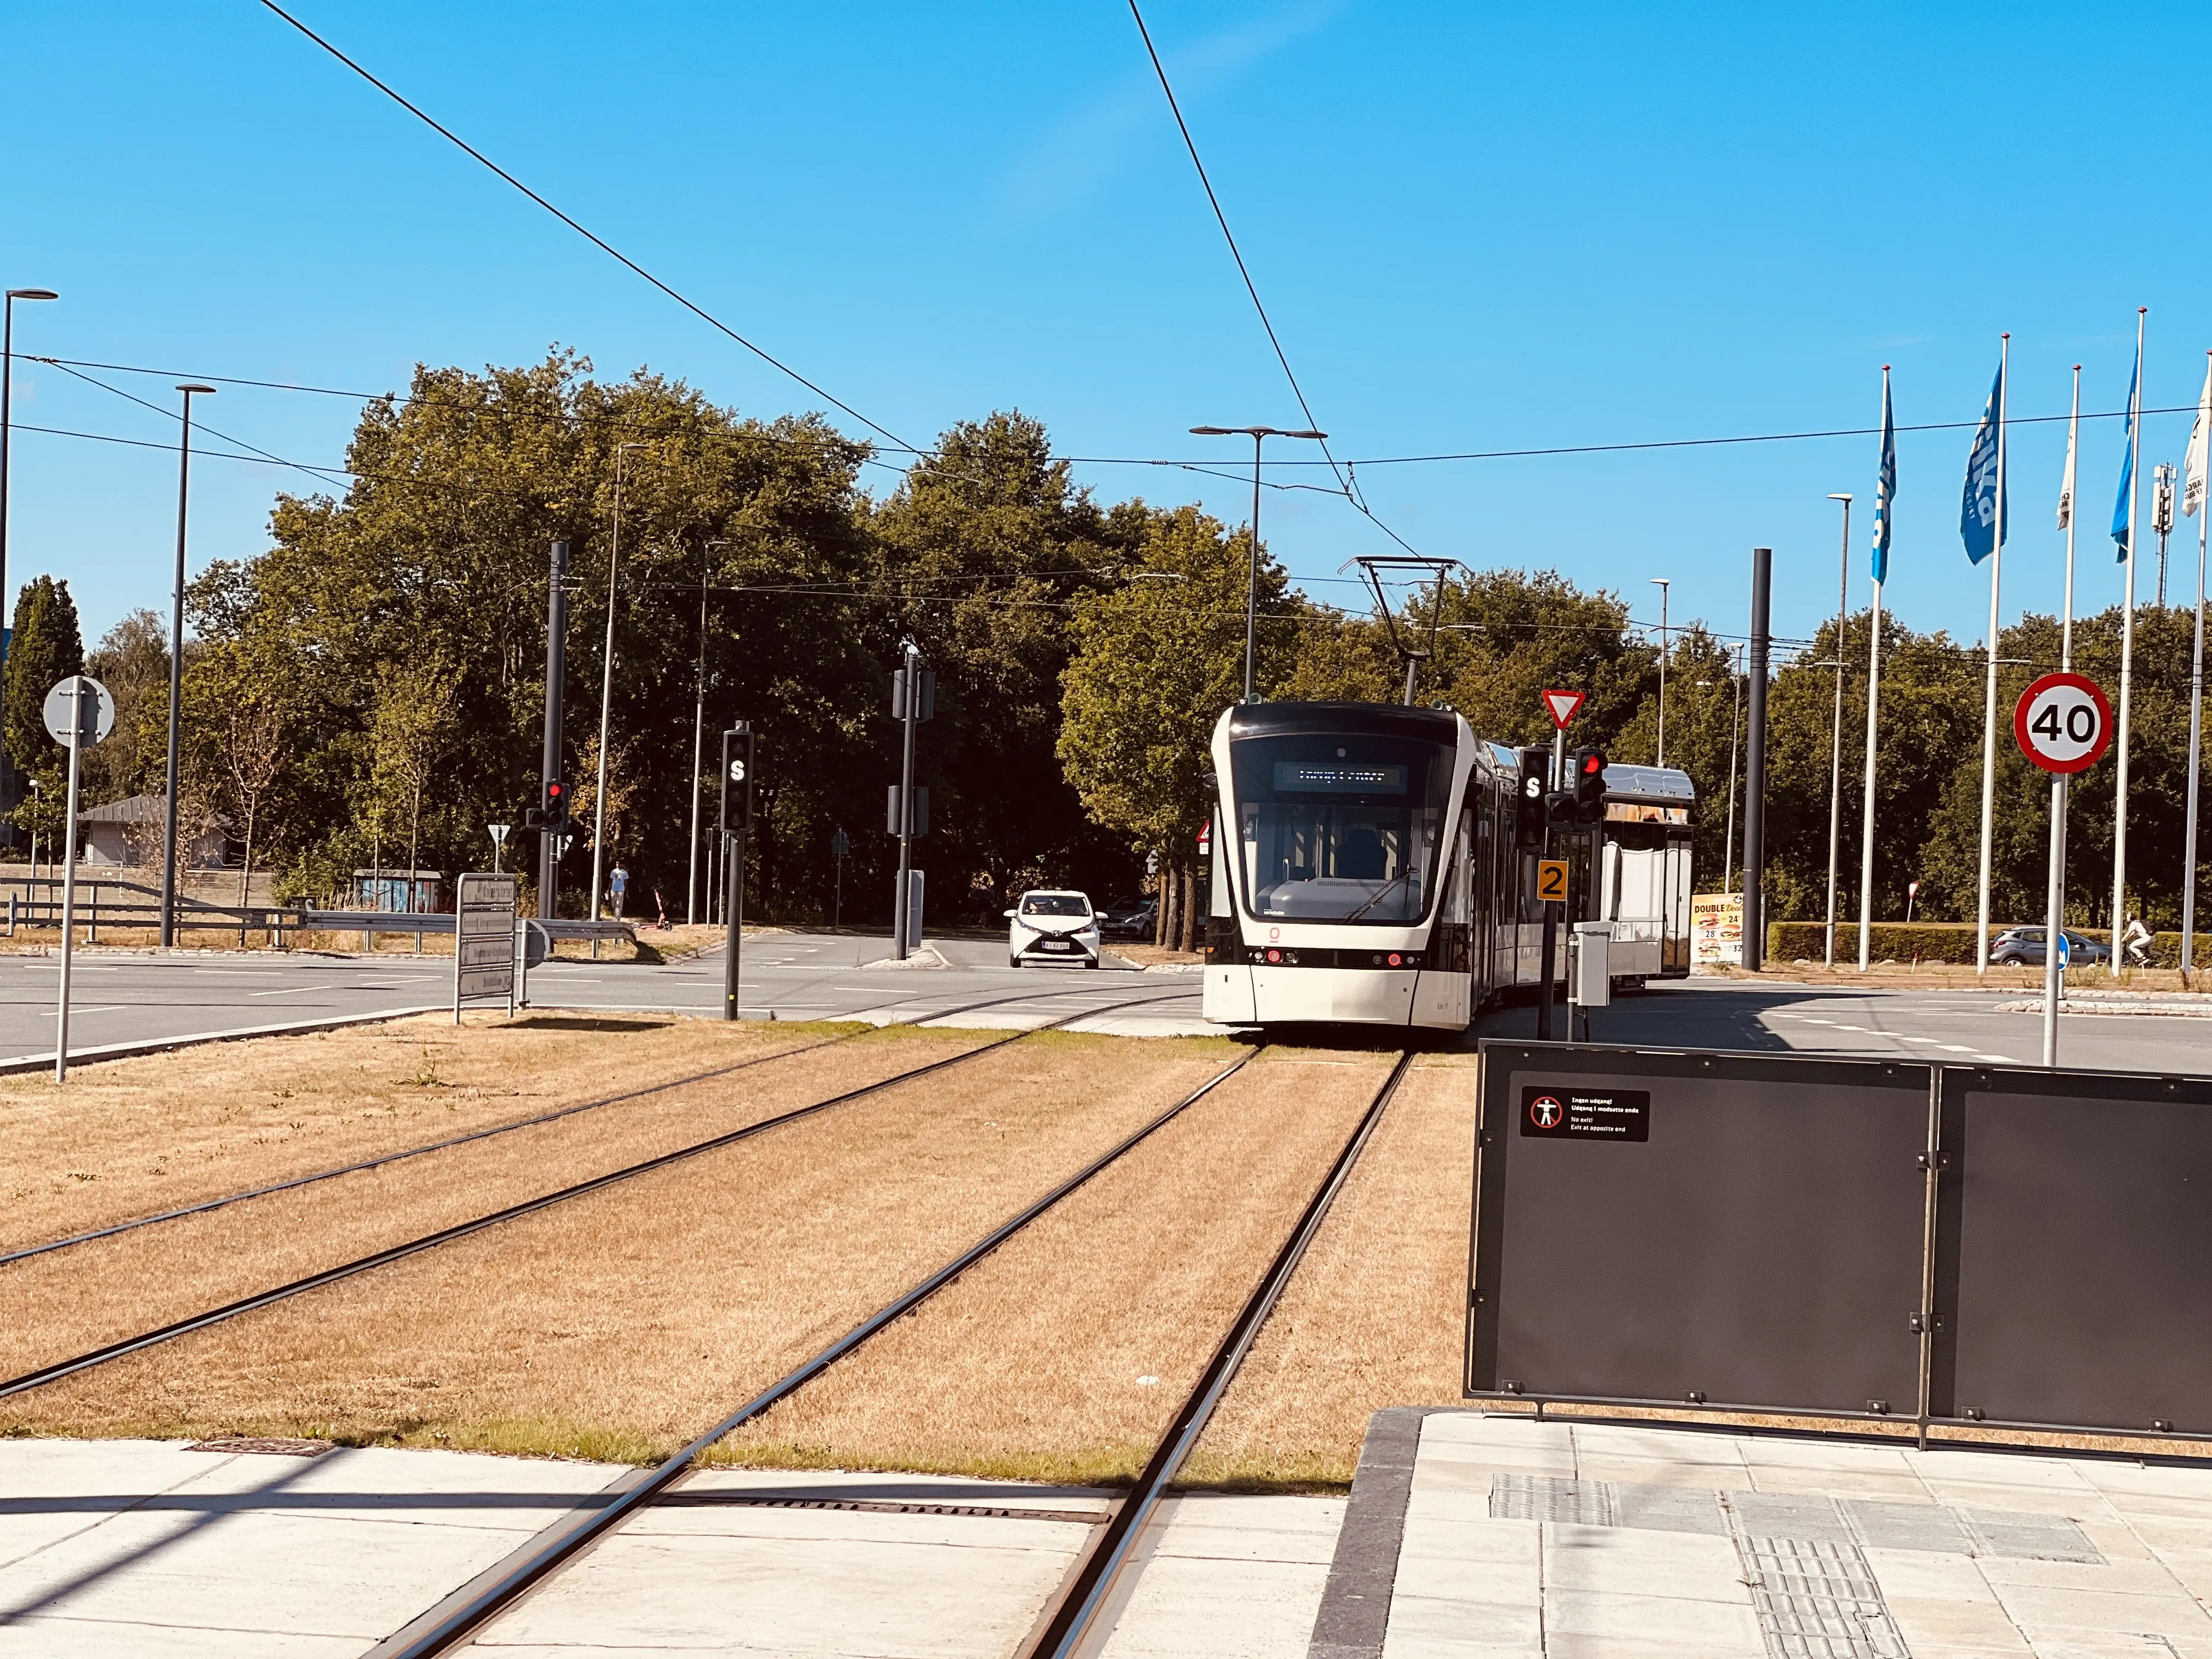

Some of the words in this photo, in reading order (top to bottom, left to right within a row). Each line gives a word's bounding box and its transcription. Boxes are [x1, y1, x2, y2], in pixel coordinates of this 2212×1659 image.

[2032, 704, 2095, 743] 40
[730, 760, 744, 781] S
[1526, 777, 1540, 797] S
[1542, 866, 1563, 895] 2
[1695, 905, 1724, 913] DOUBLE
